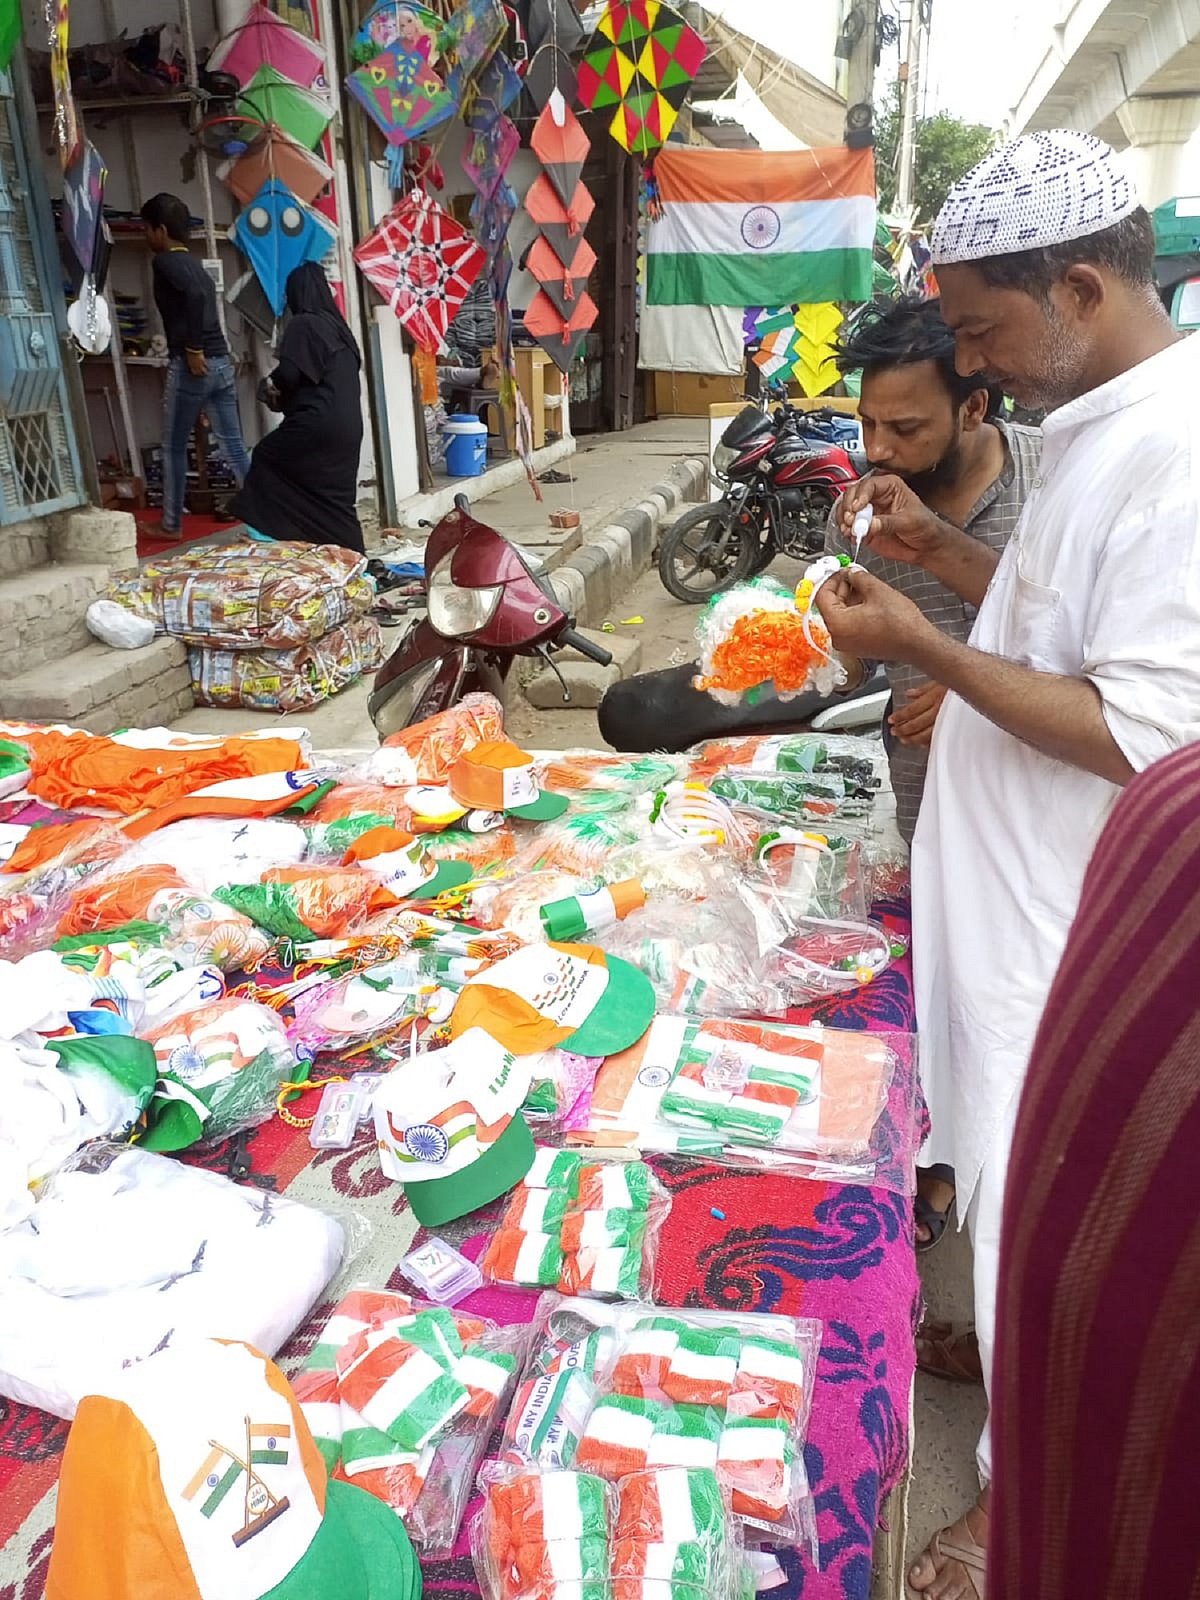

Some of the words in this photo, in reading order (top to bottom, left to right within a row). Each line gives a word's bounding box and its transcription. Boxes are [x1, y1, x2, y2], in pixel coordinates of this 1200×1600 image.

[488, 1084, 498, 1095] I
[523, 1410, 536, 1428] MY
[533, 1375, 554, 1407] INDIA
[250, 1494, 267, 1509] HIND
